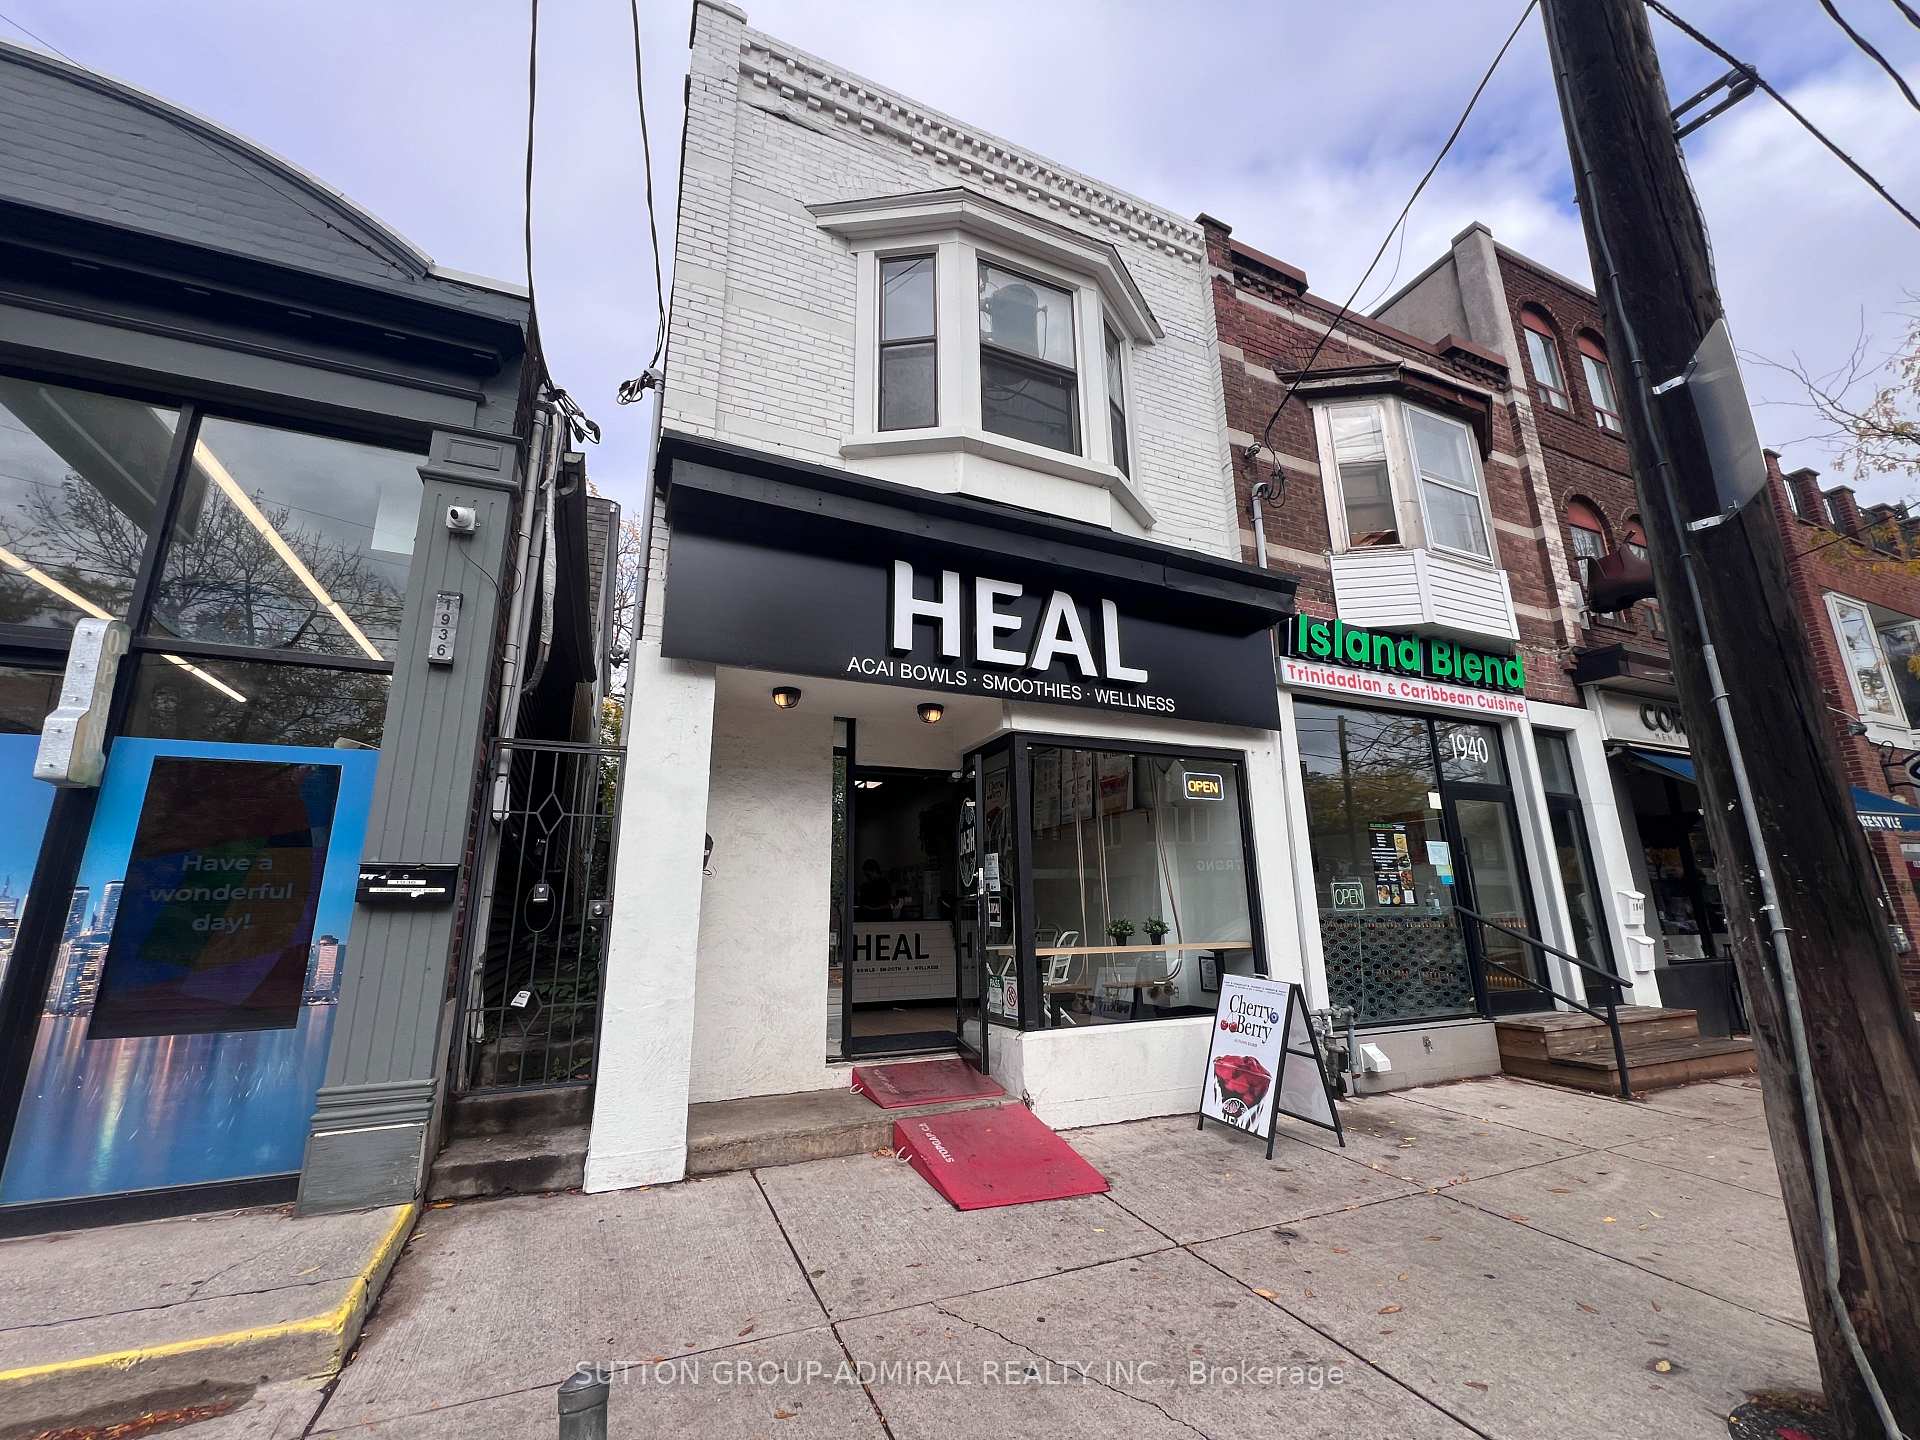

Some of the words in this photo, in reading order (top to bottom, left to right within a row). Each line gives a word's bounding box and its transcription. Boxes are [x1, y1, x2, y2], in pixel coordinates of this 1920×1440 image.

[893, 559, 1149, 684] HEAL
[1298, 613, 1421, 672] Island
[1431, 639, 1525, 689] Blend
[847, 656, 894, 677] ACAI
[900, 663, 968, 686] BOWLS
[982, 673, 1082, 700] SMOOTHIES
[1094, 688, 1176, 713] WELLNESS
[1287, 664, 1382, 693] Trinidadian
[1387, 682, 1397, 695] &
[1401, 682, 1474, 706] Caribbean
[1477, 694, 1524, 713] Cuisine
[1449, 733, 1489, 763] 1940
[1187, 780, 1219, 794] OPEN
[181, 855, 250, 872] Have
[256, 857, 273, 871] a
[150, 882, 294, 901] wonderful
[1334, 888, 1363, 905] OPEN
[191, 913, 254, 935] day!
[852, 933, 930, 961] HEAL
[1229, 994, 1274, 1024] Cherry
[1236, 1014, 1273, 1044] Berry
[919, 1122, 955, 1163] STOPGAP.CA
